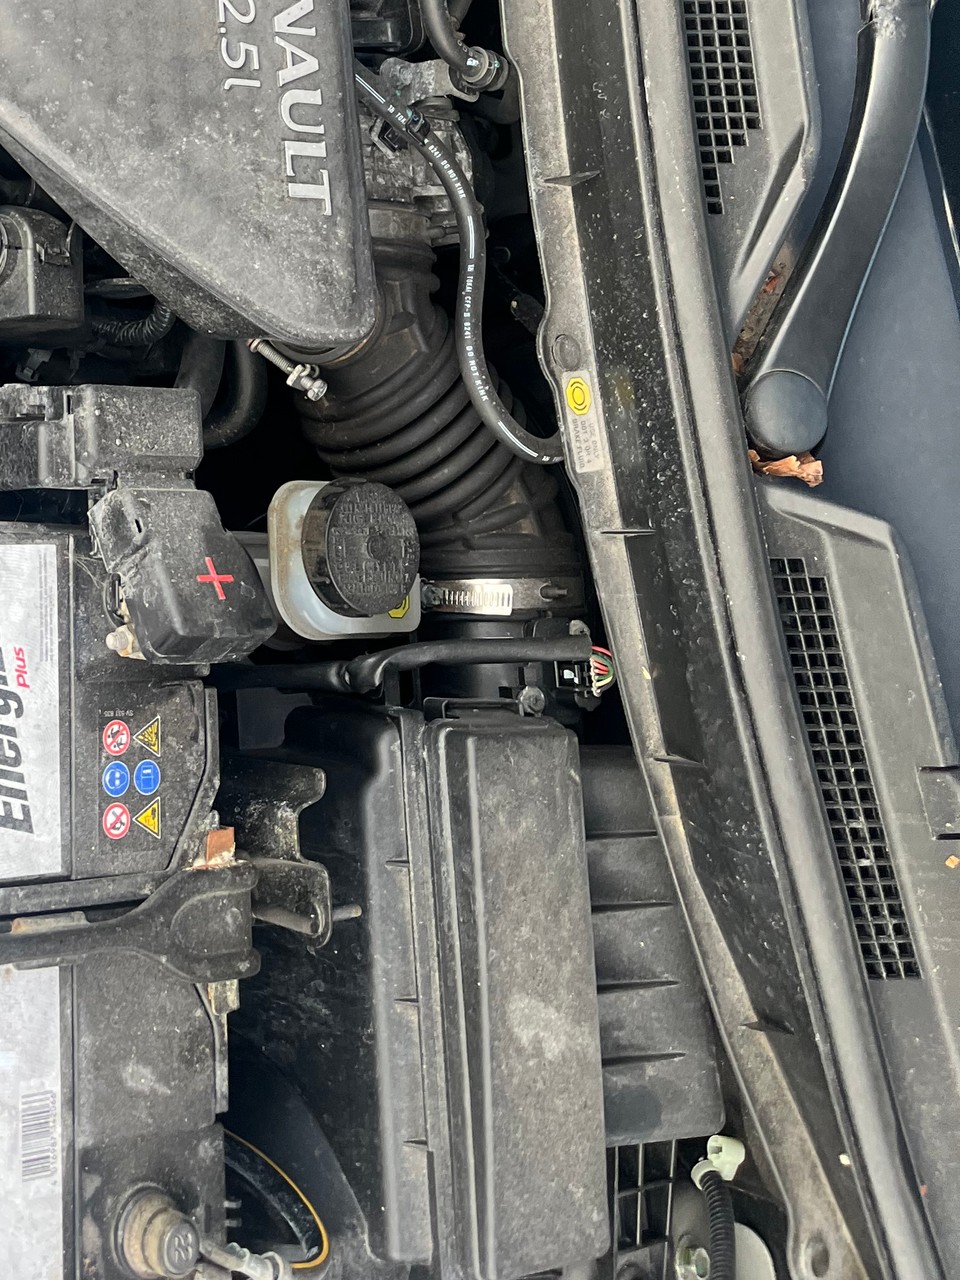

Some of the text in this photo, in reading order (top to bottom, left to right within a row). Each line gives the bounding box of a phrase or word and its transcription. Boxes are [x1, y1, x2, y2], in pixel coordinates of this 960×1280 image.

[465, 345, 475, 358] DO
[468, 359, 480, 378] NOT
[474, 380, 490, 403] KINK
[572, 418, 585, 468] BRAKE FLUID
